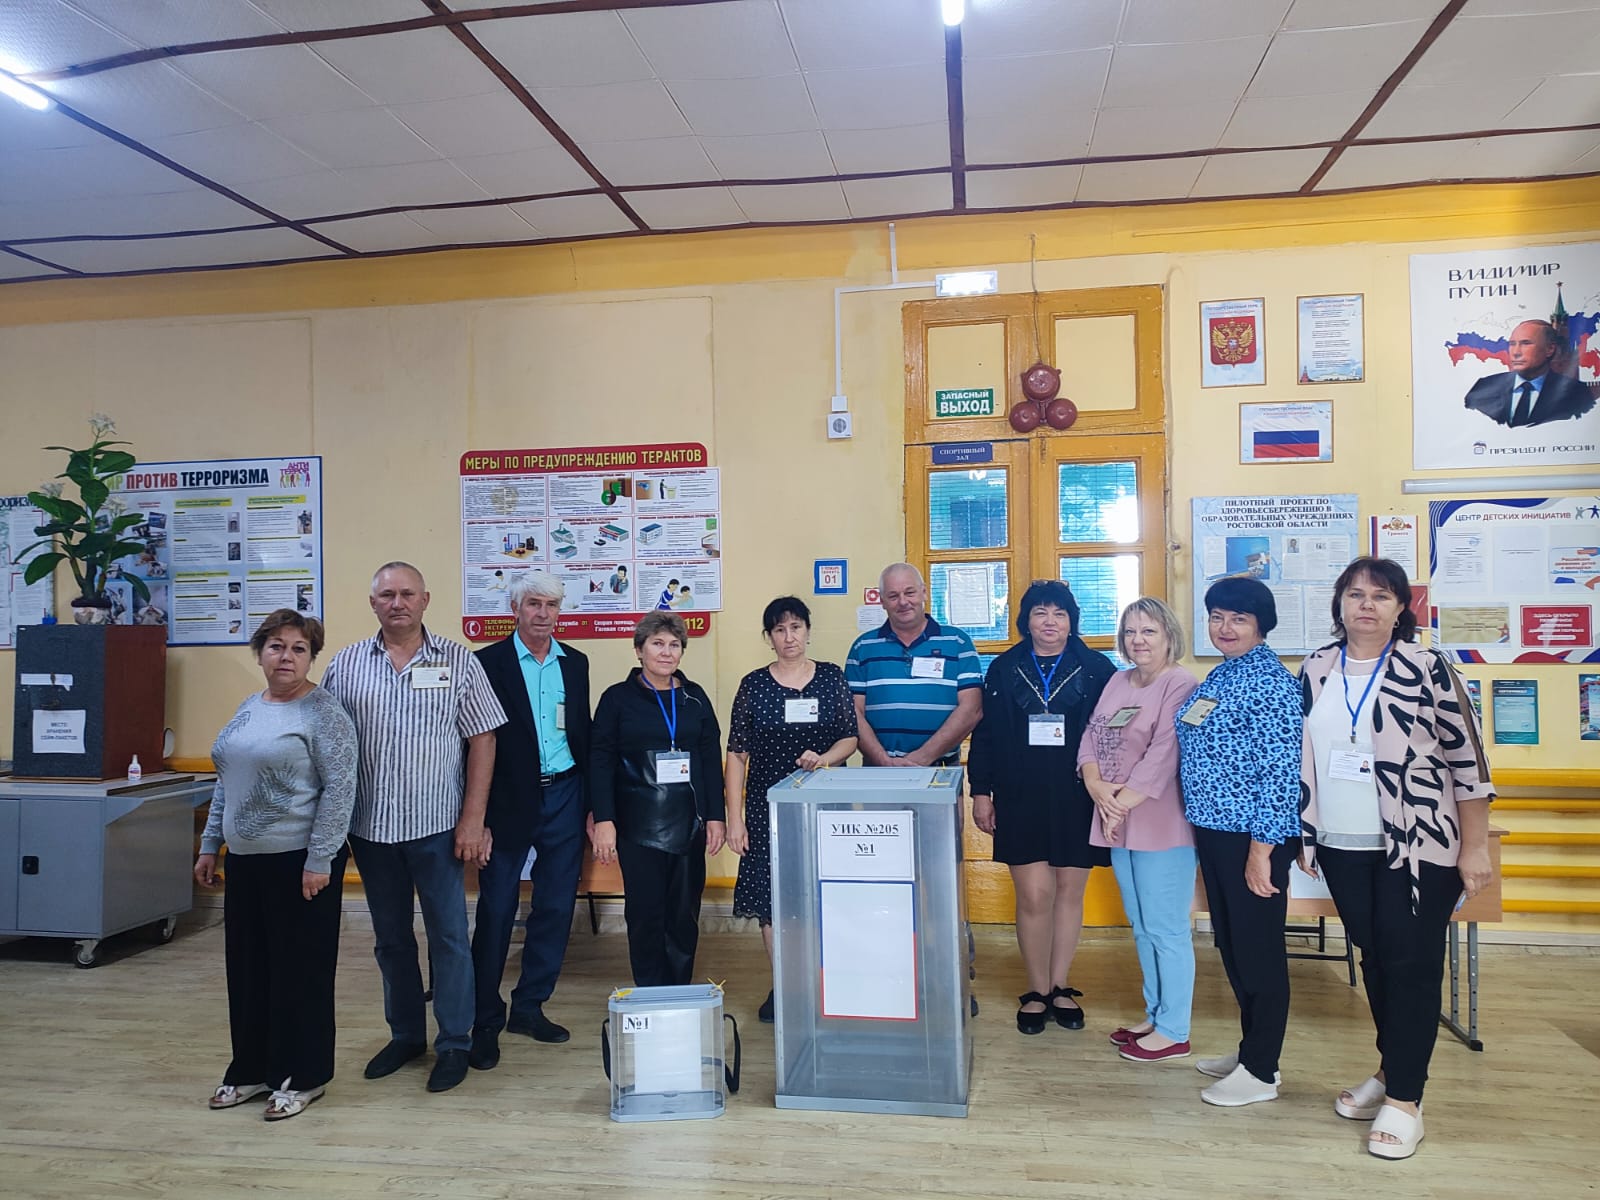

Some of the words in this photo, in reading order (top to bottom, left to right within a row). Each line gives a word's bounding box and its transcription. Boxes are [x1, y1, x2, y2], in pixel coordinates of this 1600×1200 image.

[1449, 263, 1561, 282] ВЛАДИМИР
[1449, 284, 1517, 299] ПУТИН
[941, 391, 989, 400] ЗАПАСНЫЙ
[940, 399, 990, 414] ВЫХОД
[940, 447, 985, 455] СПОРТИВНЫЙ
[1489, 446, 1546, 455] ПРЕЗИДЕНТ
[1552, 445, 1596, 453] РОССИИ
[465, 456, 500, 471] МЕРЫ
[504, 455, 519, 469] ПО
[523, 451, 637, 469] ПРЕДУПРЕЖДЕНИЮ
[641, 449, 702, 465] ТЕРАКТОВ
[126, 472, 178, 490] ПРОТИВ
[181, 468, 270, 487] ТЕРРОРИЗМА
[1225, 499, 1275, 507] ПИЛОТНЫЙ
[1221, 506, 1324, 515] ЗДОРОВЬЕСБЕРЕЖЕНИЮ
[1201, 514, 1286, 522] ОБРАЗОВАТЕЛЬНЫХ
[1288, 513, 1354, 521] УЧРЕЖДЕНИЯХ
[1455, 513, 1482, 522] ЦЕНТР
[1482, 513, 1519, 521] ДЕТСКИХ
[1521, 512, 1571, 520] ИНИЦИАТИВ
[1227, 521, 1284, 529] РОСТОВСКОЙ
[824, 575, 837, 584] 01
[684, 617, 705, 630] 112
[831, 823, 861, 834] УИК
[864, 823, 899, 834] №205
[855, 843, 875, 854] №1
[625, 1017, 649, 1030] №1
